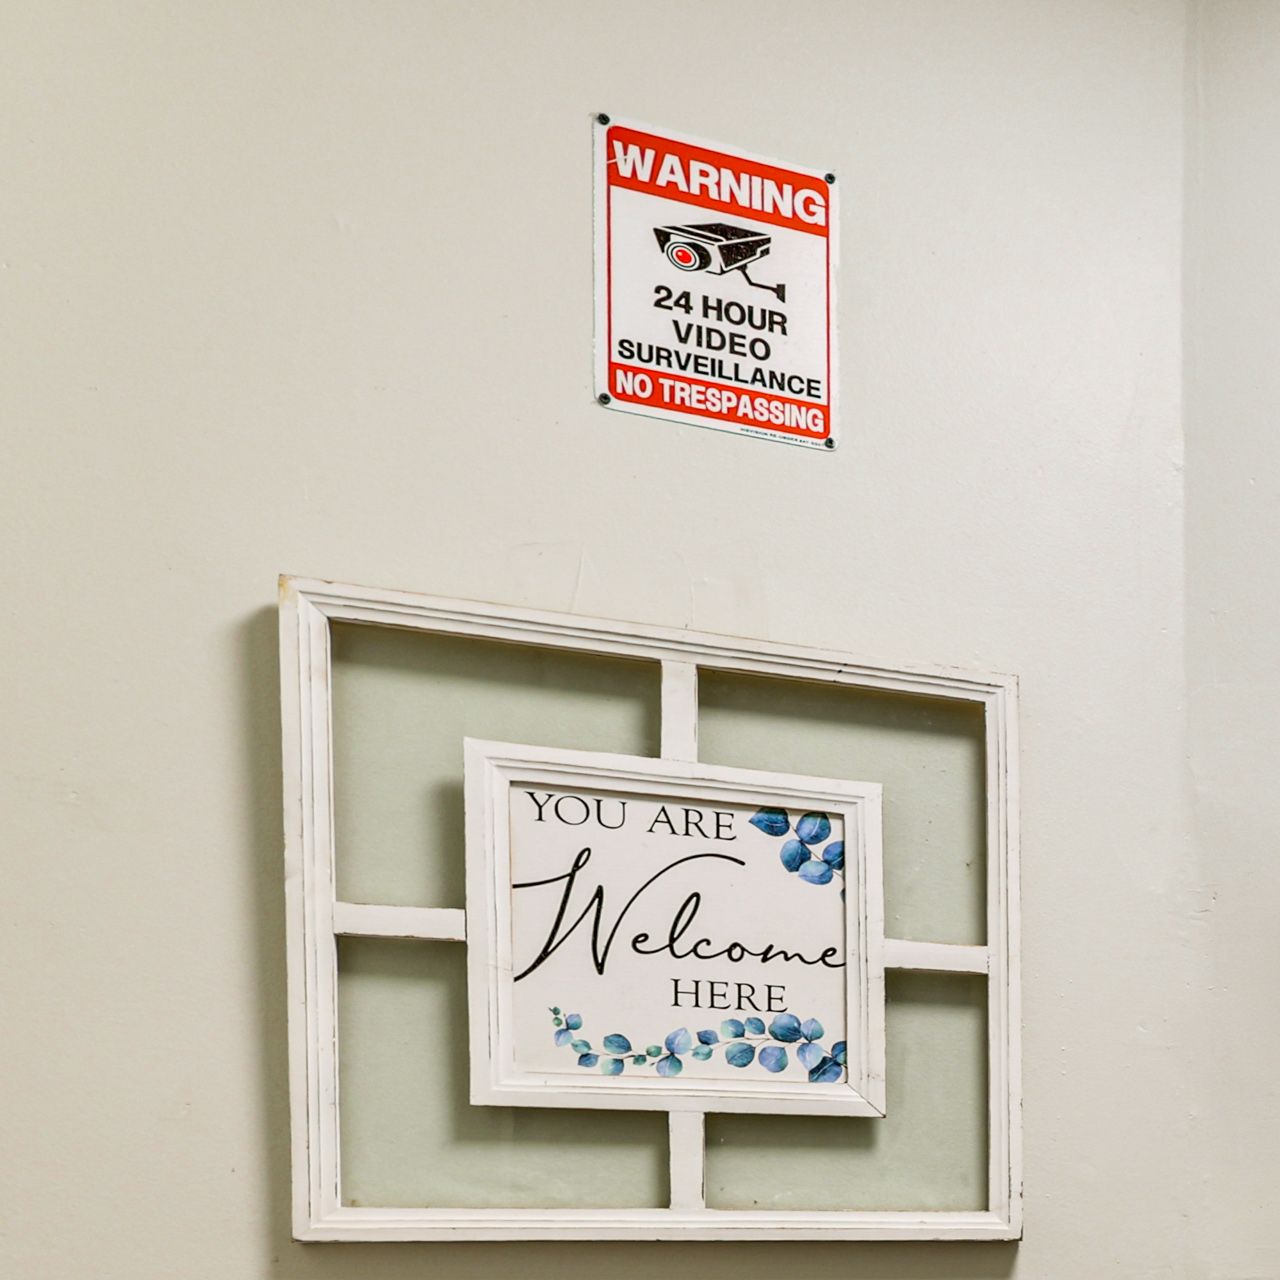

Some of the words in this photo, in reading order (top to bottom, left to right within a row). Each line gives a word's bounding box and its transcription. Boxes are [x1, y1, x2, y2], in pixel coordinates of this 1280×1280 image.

[612, 138, 827, 226] WARNING
[653, 285, 694, 315] 24
[703, 294, 788, 336] HOUR
[672, 320, 771, 361] VIDEO
[618, 339, 822, 399] SURVEILLANCE
[615, 369, 653, 399] NO
[659, 377, 824, 433] TRESPASSING
[525, 791, 627, 830] YOU
[646, 805, 737, 841] ARE
[511, 846, 847, 983] Welcome
[670, 977, 788, 1013] HERE
